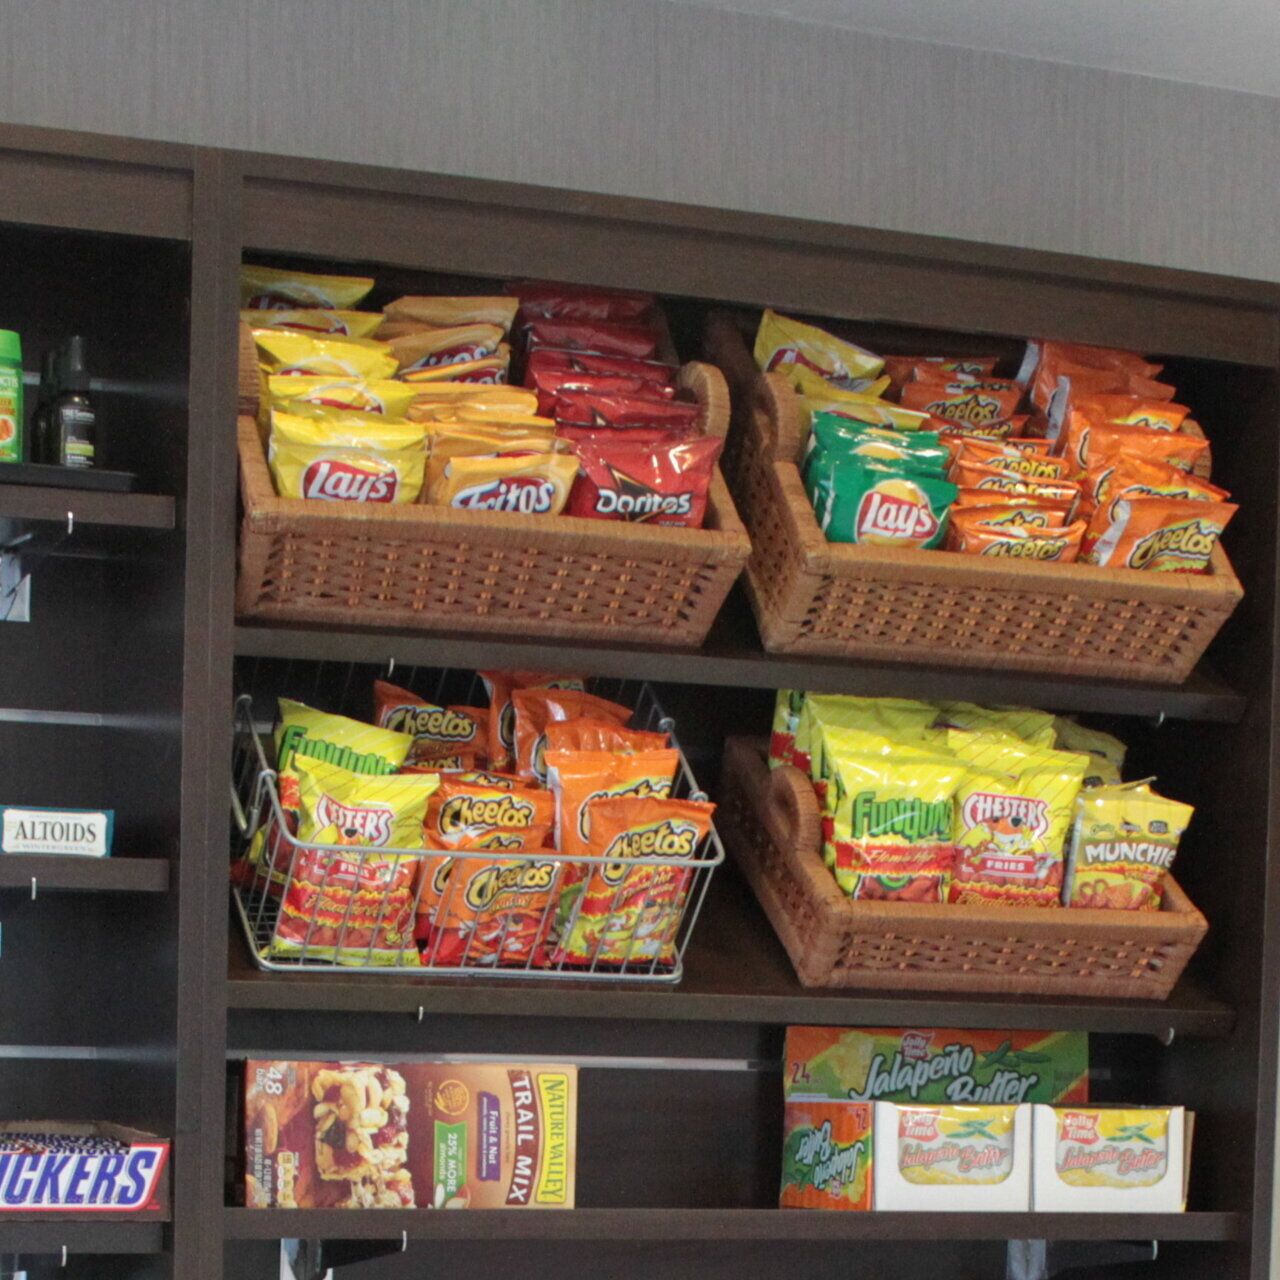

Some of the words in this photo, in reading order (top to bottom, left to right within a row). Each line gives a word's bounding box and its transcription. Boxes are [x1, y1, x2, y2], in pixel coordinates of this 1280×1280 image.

[306, 460, 395, 502] Lay's
[596, 489, 691, 514] Doritos
[861, 493, 934, 538] Lay's
[1128, 520, 1215, 570] Cheetos
[383, 705, 474, 739] Cheetos
[15, 820, 96, 843] ALTOIDS
[439, 796, 531, 835] Cheetos
[602, 820, 698, 883] Cheetos
[986, 859, 1025, 871] FRIES
[1085, 842, 1177, 868] MUNCHIE
[466, 859, 558, 910] Cheetos
[265, 1066, 283, 1095] 48
[791, 1062, 811, 1085] 24
[850, 1044, 974, 1100] Jalapeño
[947, 1072, 1037, 1103] Butter
[489, 1110, 499, 1134] Fruit
[511, 1076, 533, 1147] TRAIL
[543, 1079, 565, 1139] NATURE
[1064, 1113, 1095, 1129] Jolly
[446, 1132, 457, 1156] 25%
[489, 1136, 498, 1144] &
[904, 1125, 935, 1138] Time
[1066, 1127, 1096, 1141] Time
[438, 1143, 448, 1181] almonds
[489, 1146, 499, 1164] Nut
[541, 1140, 565, 1199] VALLEY
[446, 1159, 457, 1192] MORE
[509, 1155, 533, 1202] MIX
